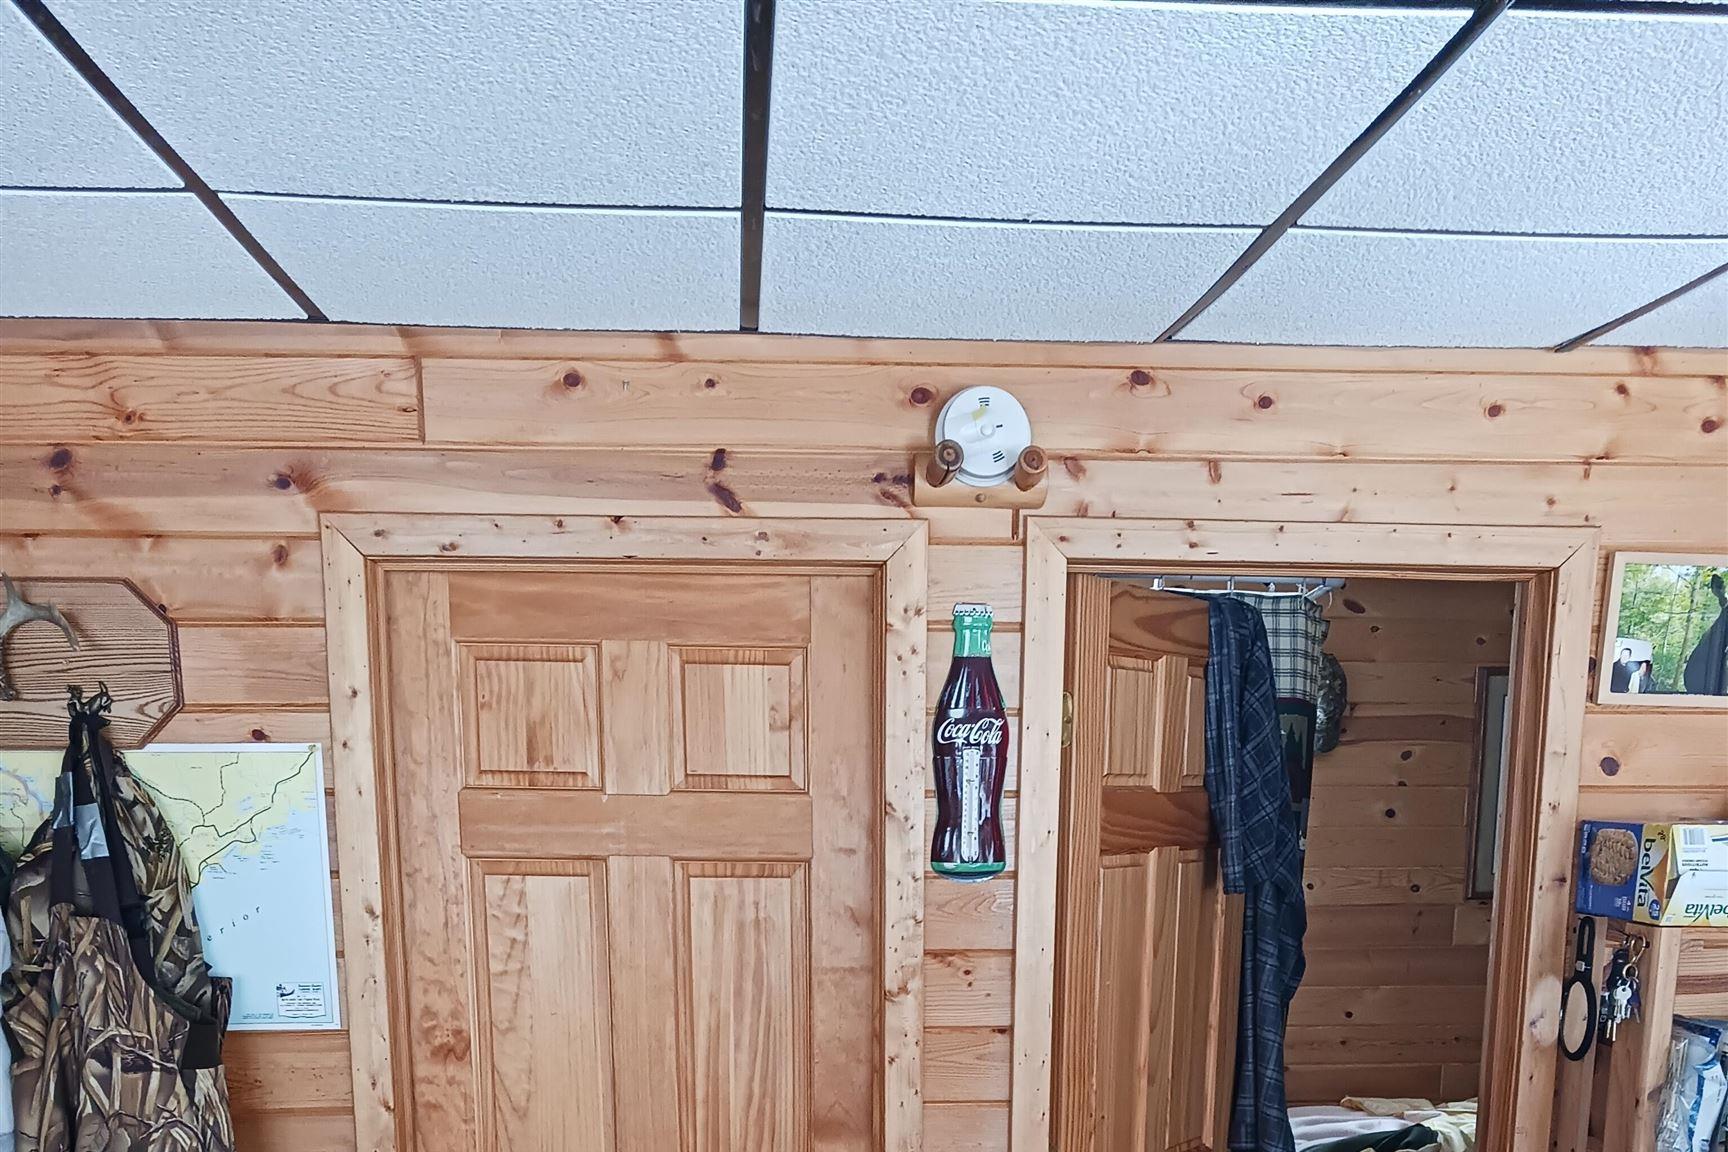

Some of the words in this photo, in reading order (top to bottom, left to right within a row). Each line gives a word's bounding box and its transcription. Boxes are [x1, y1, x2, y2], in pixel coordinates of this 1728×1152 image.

[937, 717, 1005, 744] Coca-Cola
[1637, 838, 1656, 907] belVita
[206, 905, 261, 942] erior
